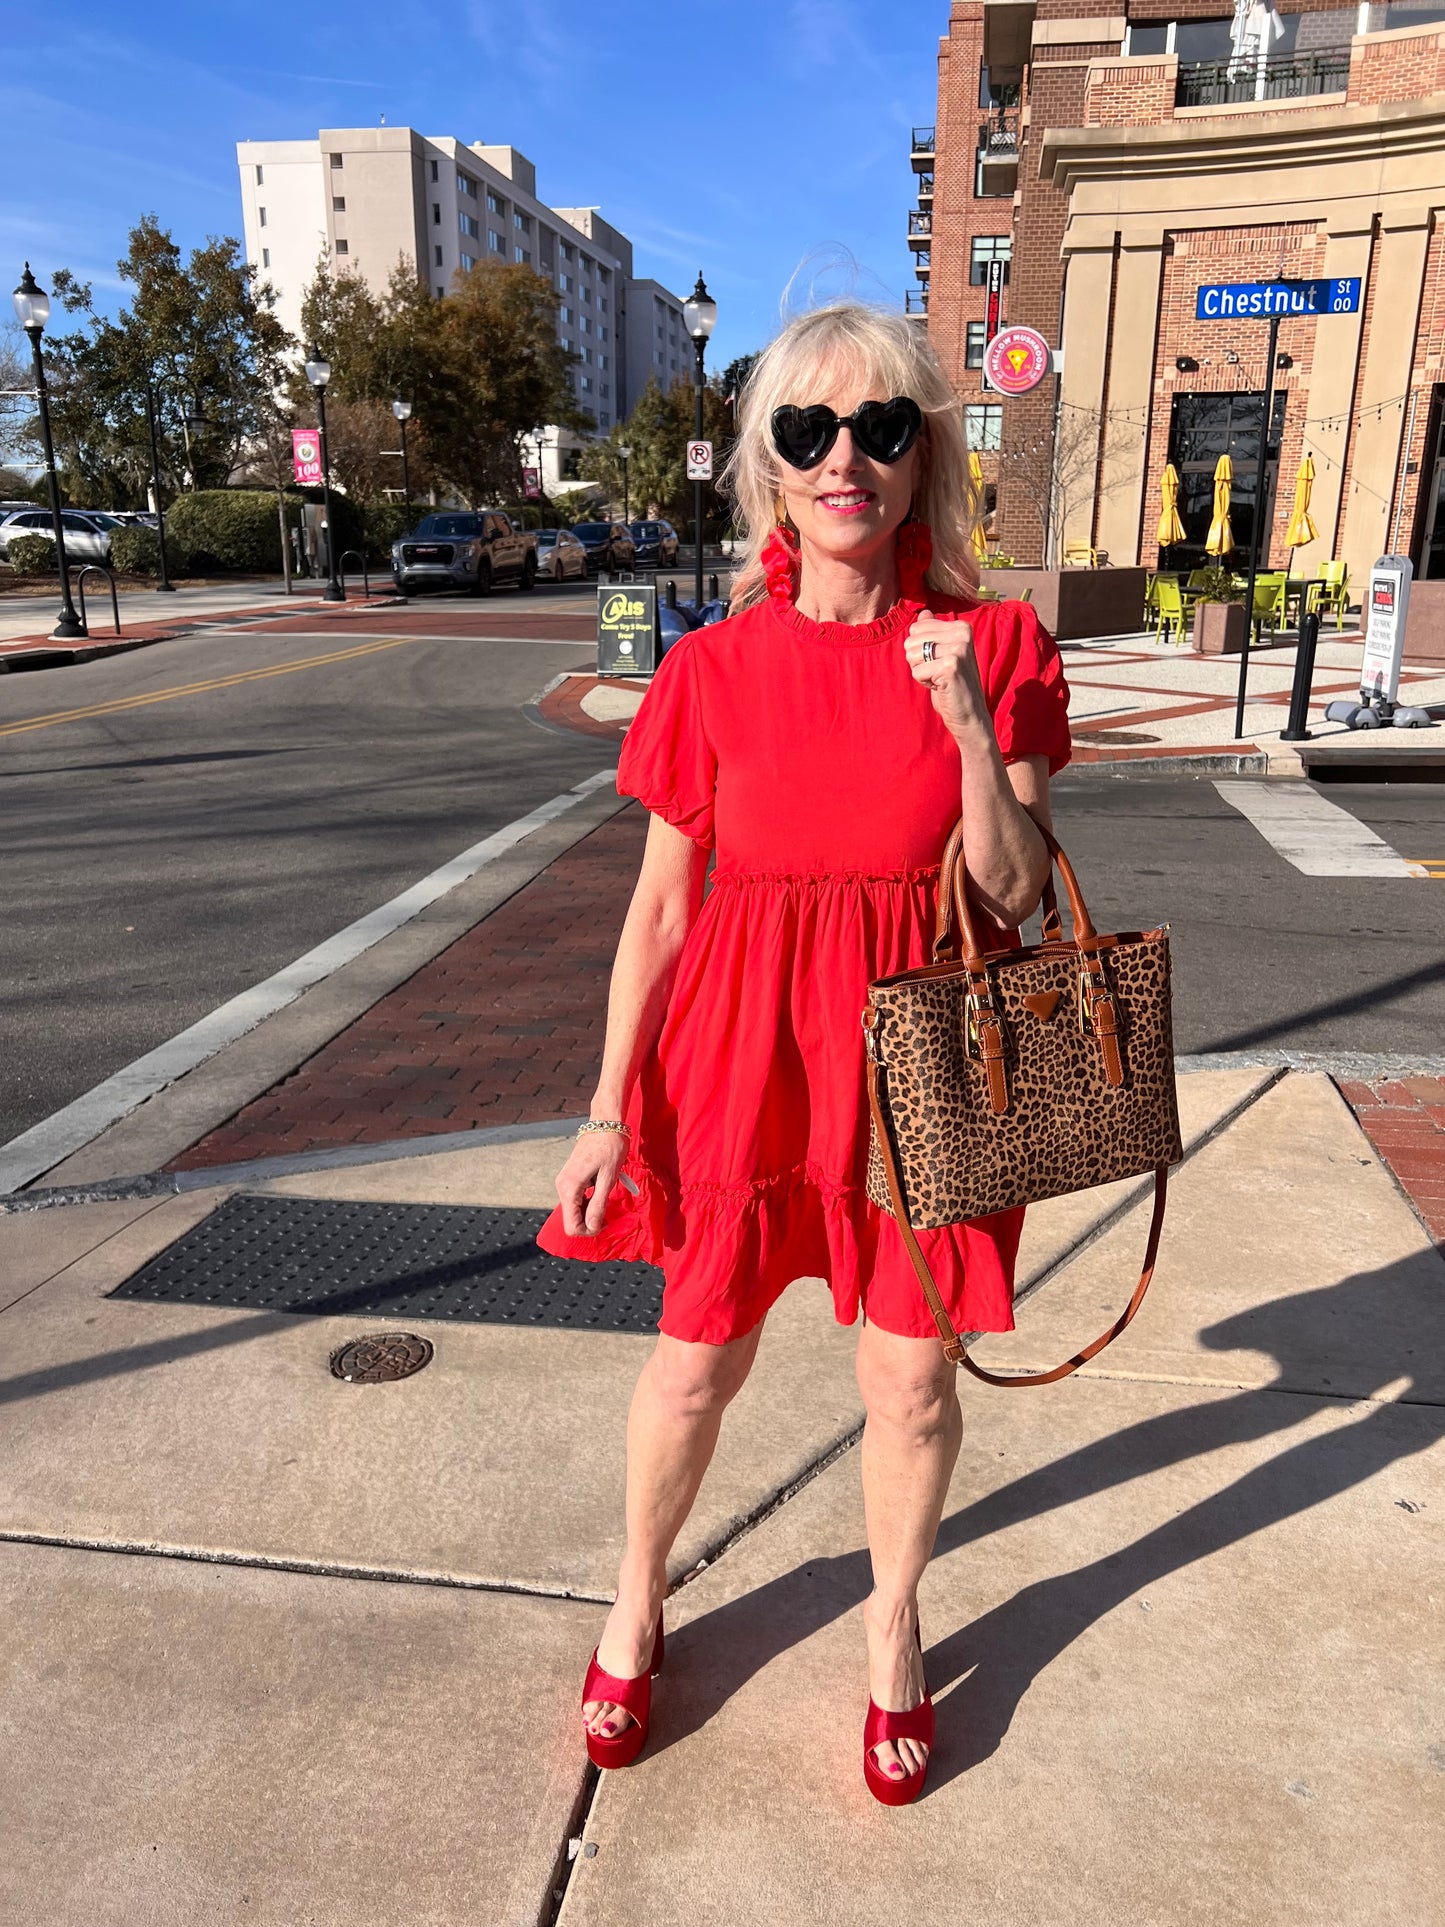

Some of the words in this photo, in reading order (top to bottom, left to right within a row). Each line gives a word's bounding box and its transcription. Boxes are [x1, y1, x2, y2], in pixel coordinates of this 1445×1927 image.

[1337, 280, 1352, 294] St
[1204, 285, 1318, 315] Chestnut
[1334, 298, 1352, 312] 00
[992, 335, 1012, 371] MELLOW
[1013, 334, 1042, 371] MUSHROOM
[297, 463, 319, 477] 100
[609, 601, 645, 616] AXIS
